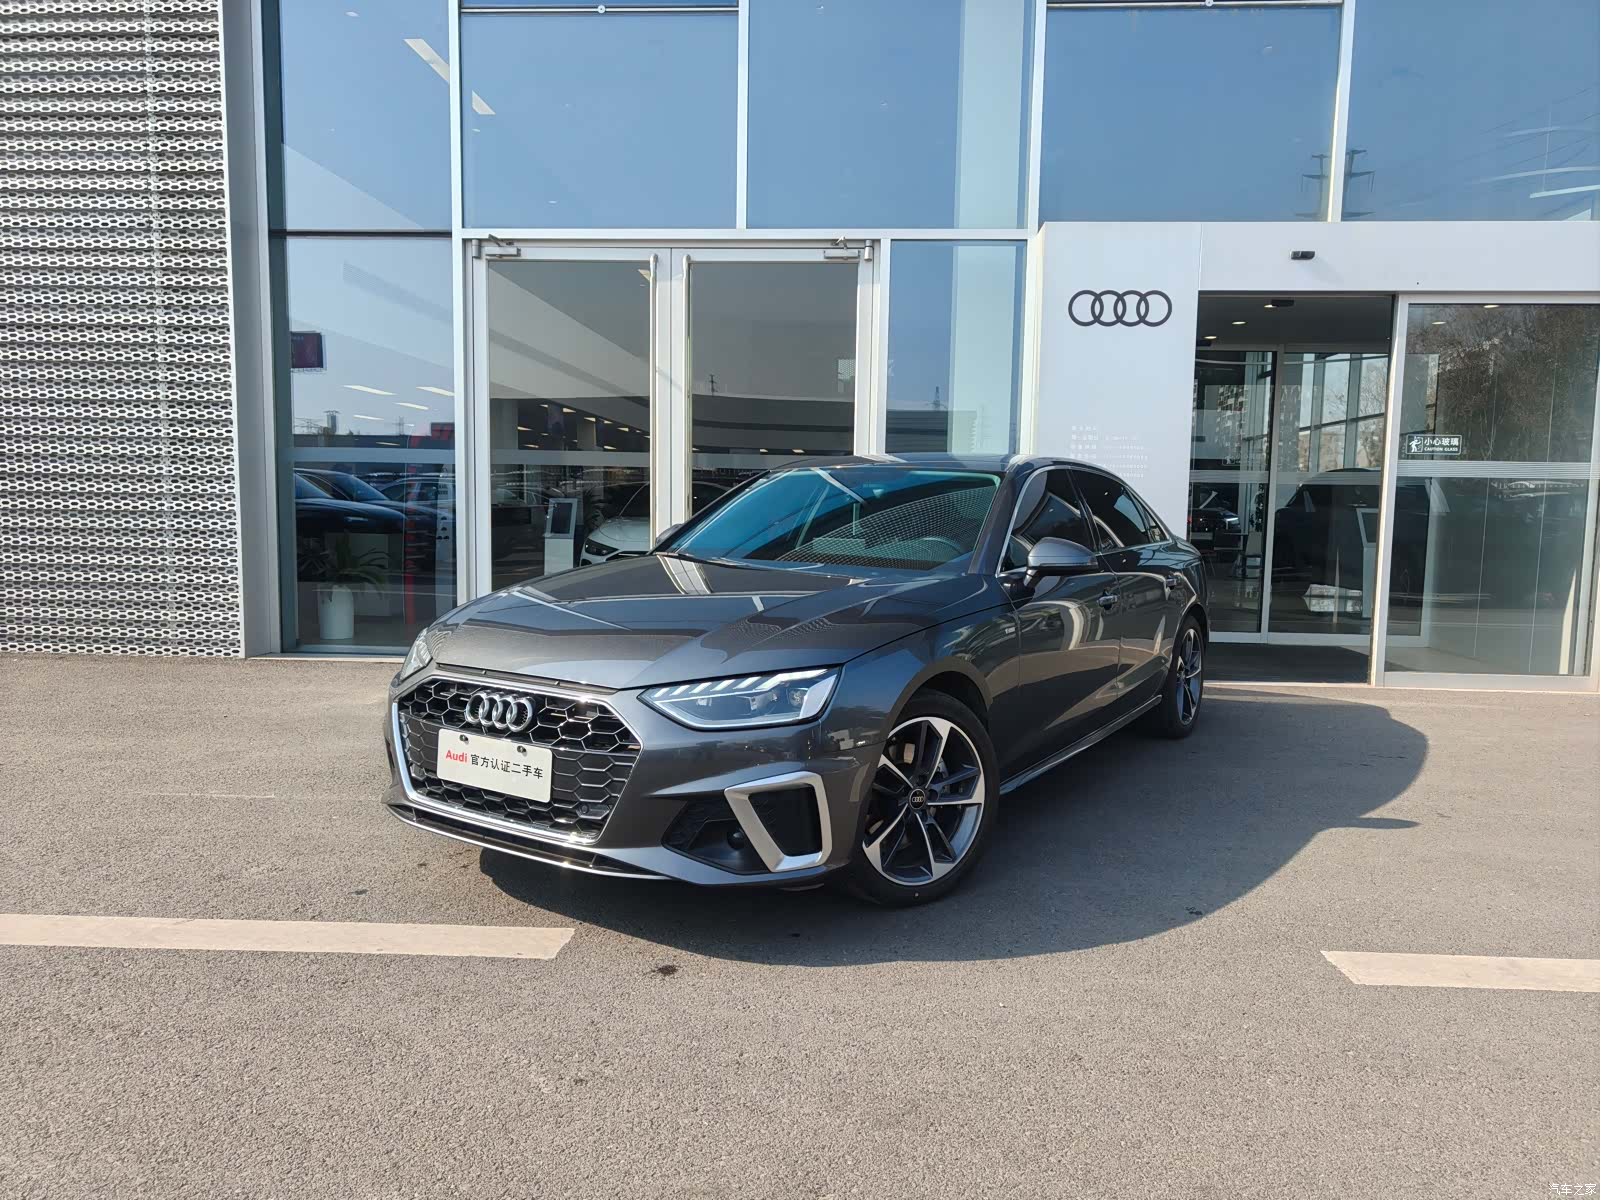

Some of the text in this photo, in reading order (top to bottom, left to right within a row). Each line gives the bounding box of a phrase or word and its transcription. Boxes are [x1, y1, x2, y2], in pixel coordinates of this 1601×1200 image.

[1424, 437, 1460, 446] 小心玻璃
[445, 750, 543, 779] Audi 官方认证二手车
